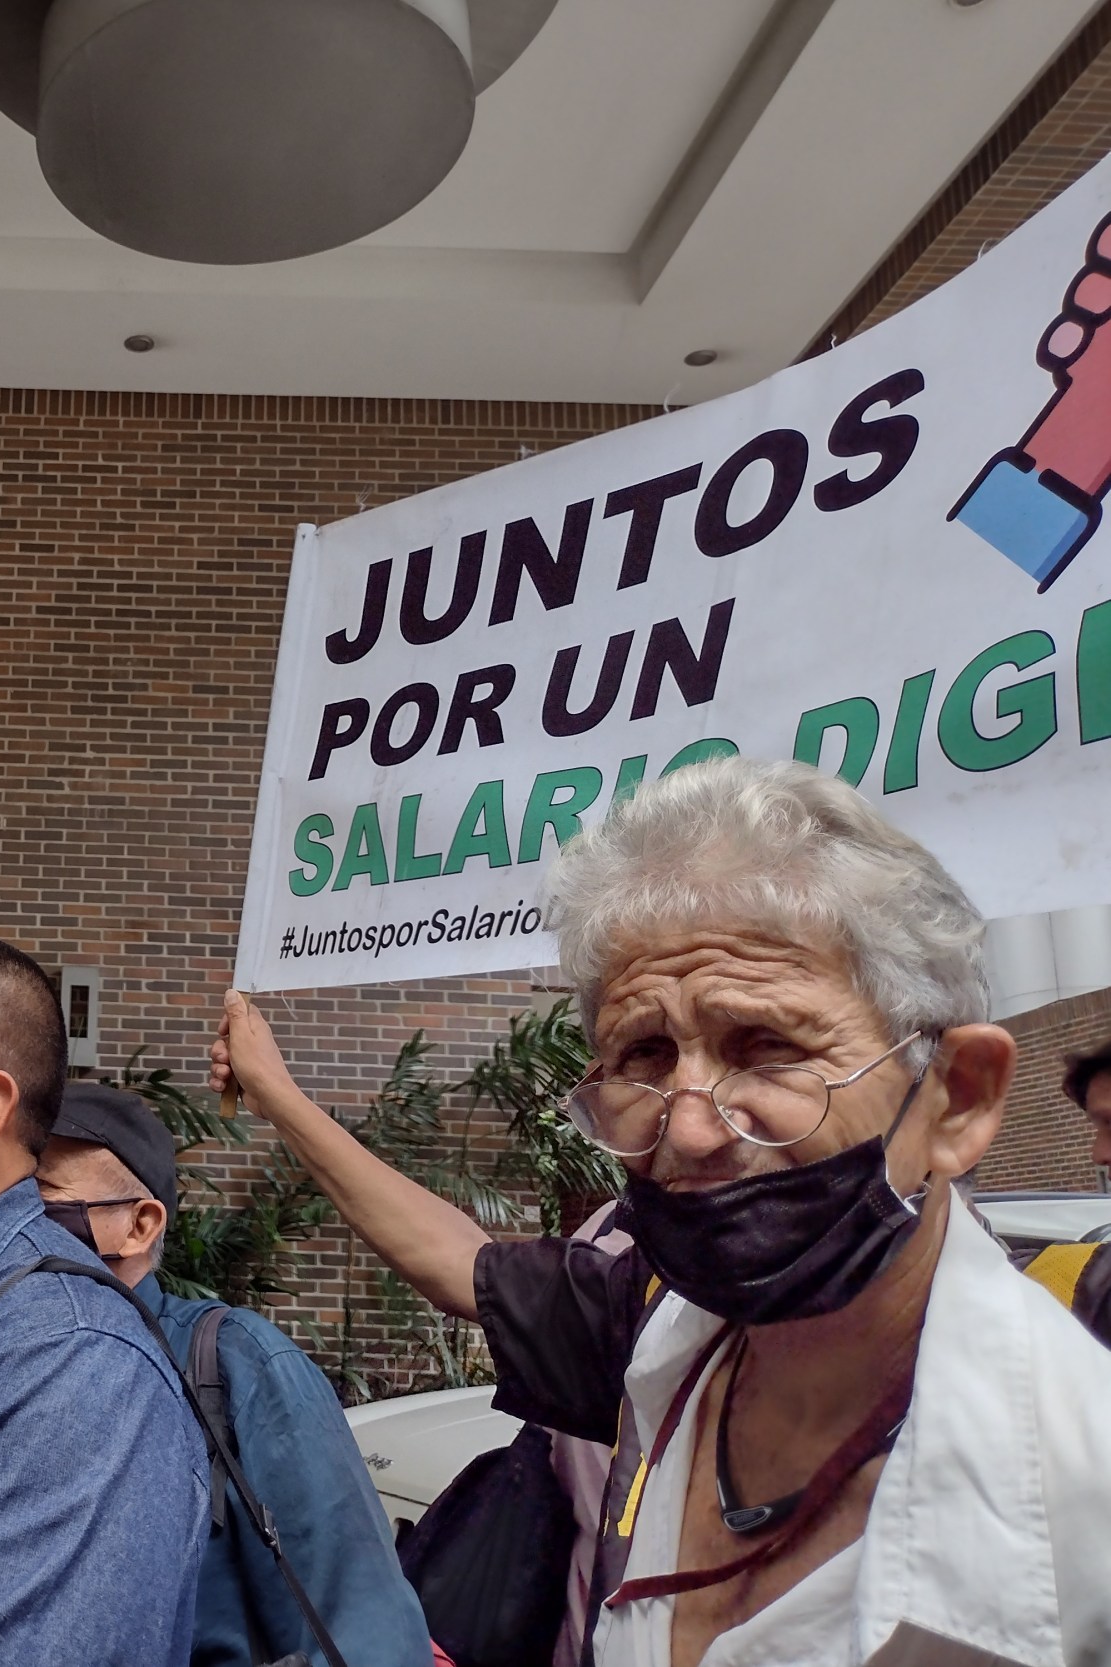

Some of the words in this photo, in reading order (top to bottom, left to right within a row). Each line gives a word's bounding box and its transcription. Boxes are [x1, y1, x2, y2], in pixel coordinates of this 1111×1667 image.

[325, 368, 925, 664] JUNTOS
[308, 663, 516, 780] POR
[541, 597, 736, 738] UN
[289, 737, 739, 897] SALARI
